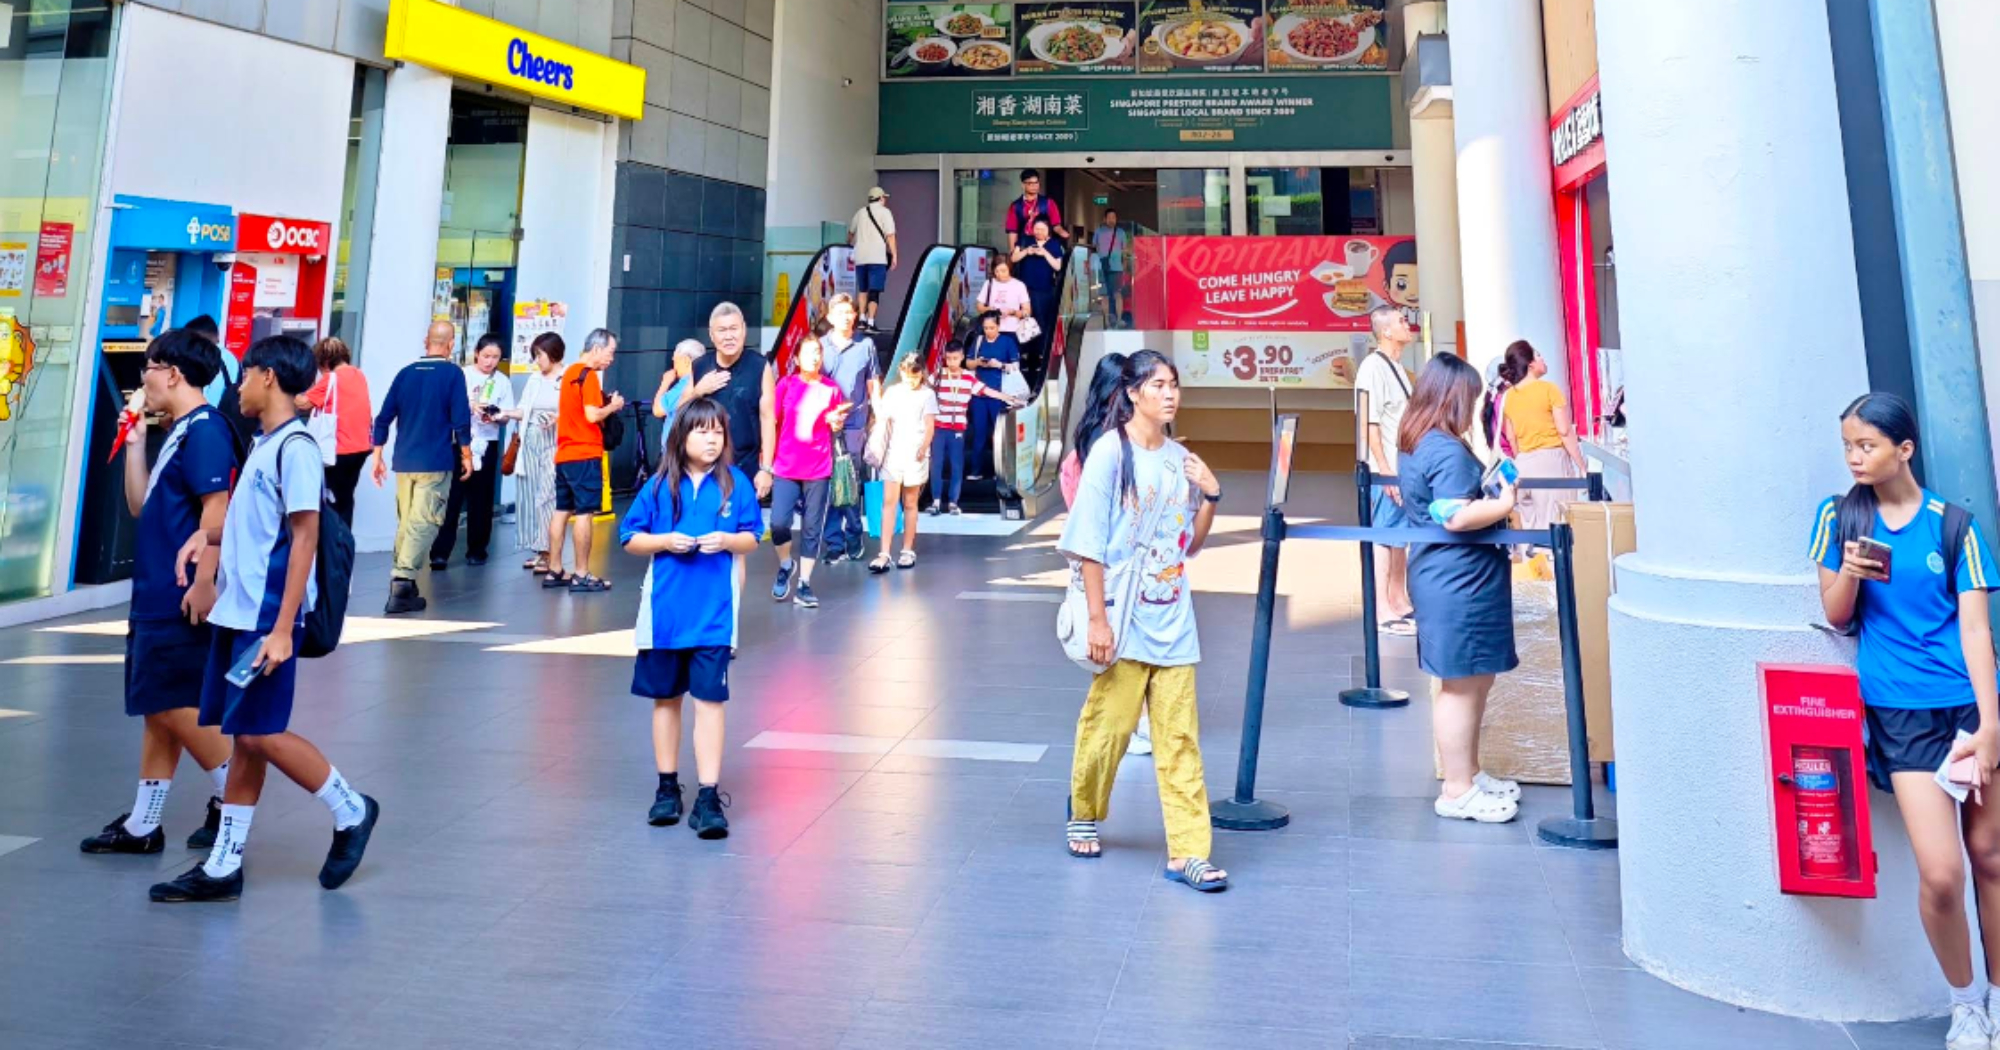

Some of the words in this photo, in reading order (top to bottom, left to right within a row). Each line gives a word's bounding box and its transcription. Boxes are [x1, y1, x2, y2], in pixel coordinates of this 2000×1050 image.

[507, 37, 573, 90] Cheers
[976, 95, 1083, 116] 湘香湖南菜
[1110, 99, 1161, 108] SINGAPORE
[1205, 99, 1238, 107] BRAND
[1240, 98, 1274, 106] AWARD
[1276, 98, 1314, 106] WINNER
[1128, 109, 1179, 117] SINGAPORE
[1182, 108, 1209, 116] LOCAL
[1212, 108, 1243, 116] BRAND
[1246, 108, 1271, 116] SINCE
[202, 223, 231, 242] POSB
[286, 226, 320, 248] OCBC
[1168, 236, 1335, 281] KOPITIAM
[1198, 274, 1238, 290] COME
[1242, 269, 1301, 286] HUNGRY
[1206, 289, 1246, 304] LEAVE
[1249, 285, 1295, 300] HAPPY
[1223, 345, 1293, 380] $3.90
[1773, 704, 1856, 719] EXTINGUISHER
[1800, 696, 1826, 707] FIRE
